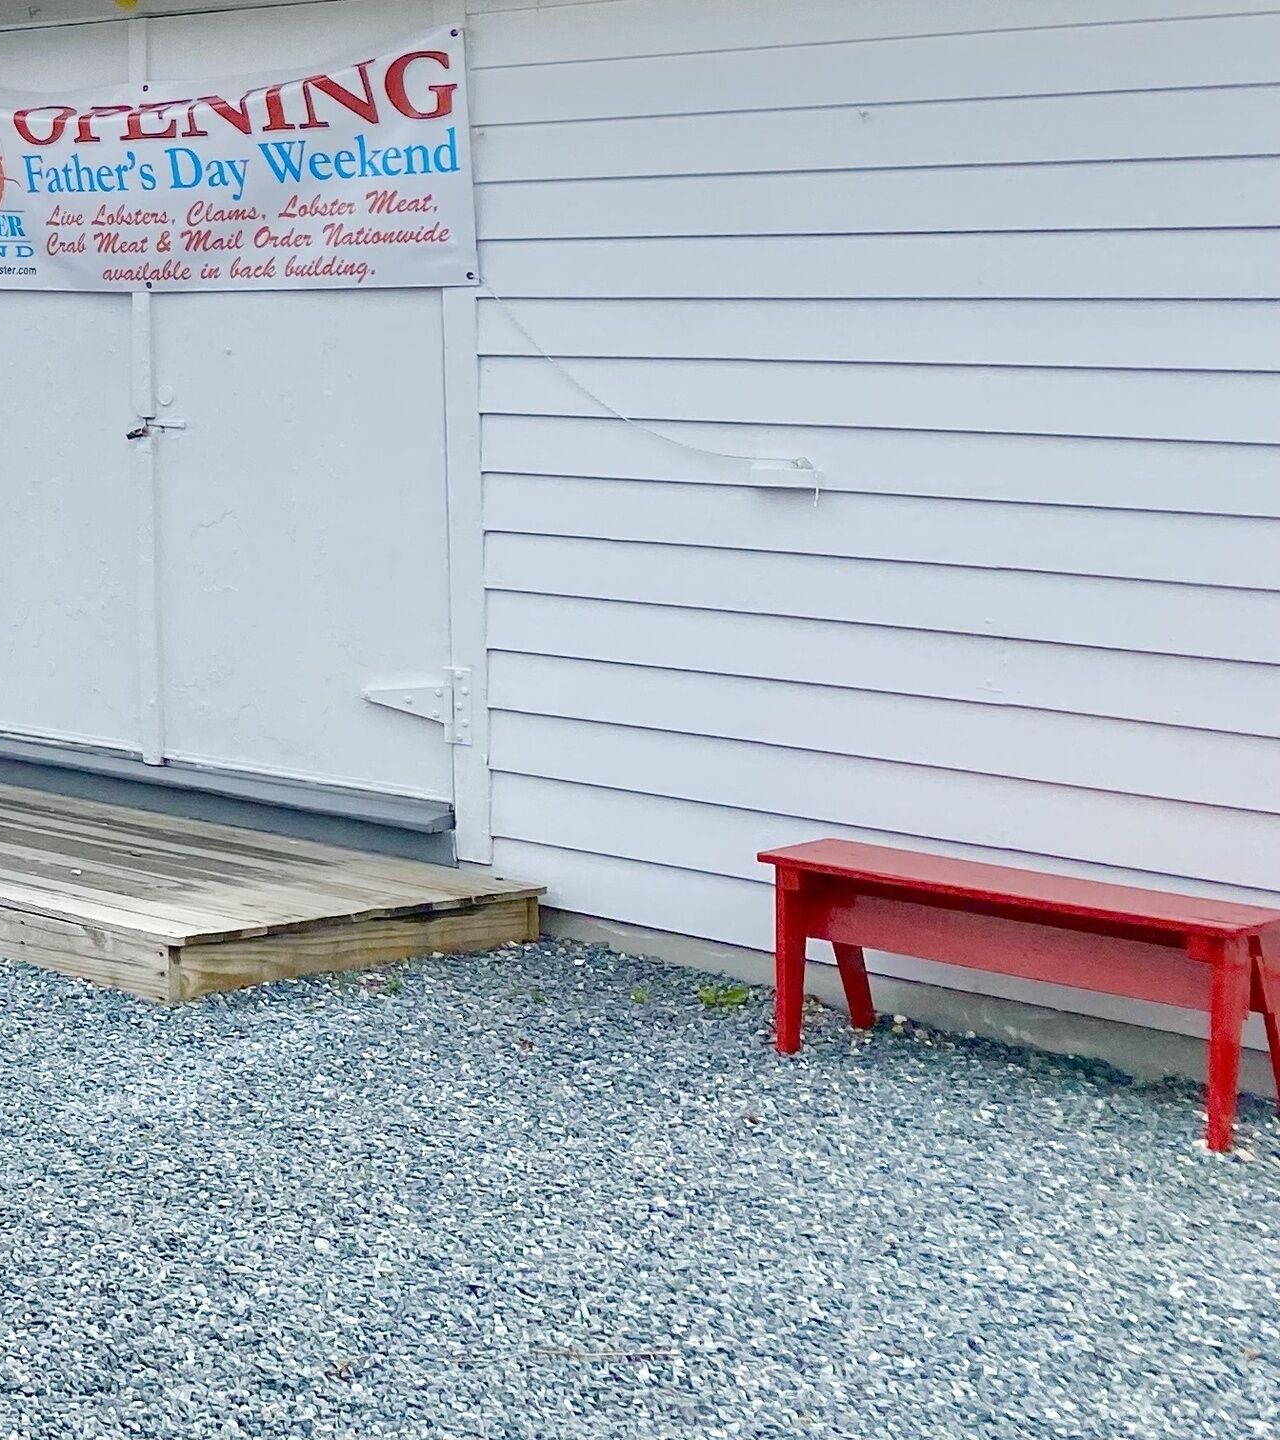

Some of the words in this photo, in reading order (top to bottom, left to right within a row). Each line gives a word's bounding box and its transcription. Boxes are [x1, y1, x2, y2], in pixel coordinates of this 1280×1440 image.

[13, 50, 458, 146] OPENING
[21, 150, 157, 195] Father's
[164, 147, 250, 201] Day
[258, 127, 461, 185] Weekend
[45, 205, 85, 227] Live
[91, 203, 176, 227] Lobsters,
[186, 200, 267, 227] Clams,
[278, 194, 357, 219] Lobster
[46, 231, 86, 256] Crab
[93, 232, 149, 255] Meat
[155, 230, 172, 253] &
[179, 229, 245, 253] Mail
[253, 225, 313, 249] Order
[321, 221, 450, 247] Nationwide
[102, 259, 192, 282] available
[200, 261, 222, 280] in
[230, 255, 277, 280] back
[284, 255, 376, 283] building.
